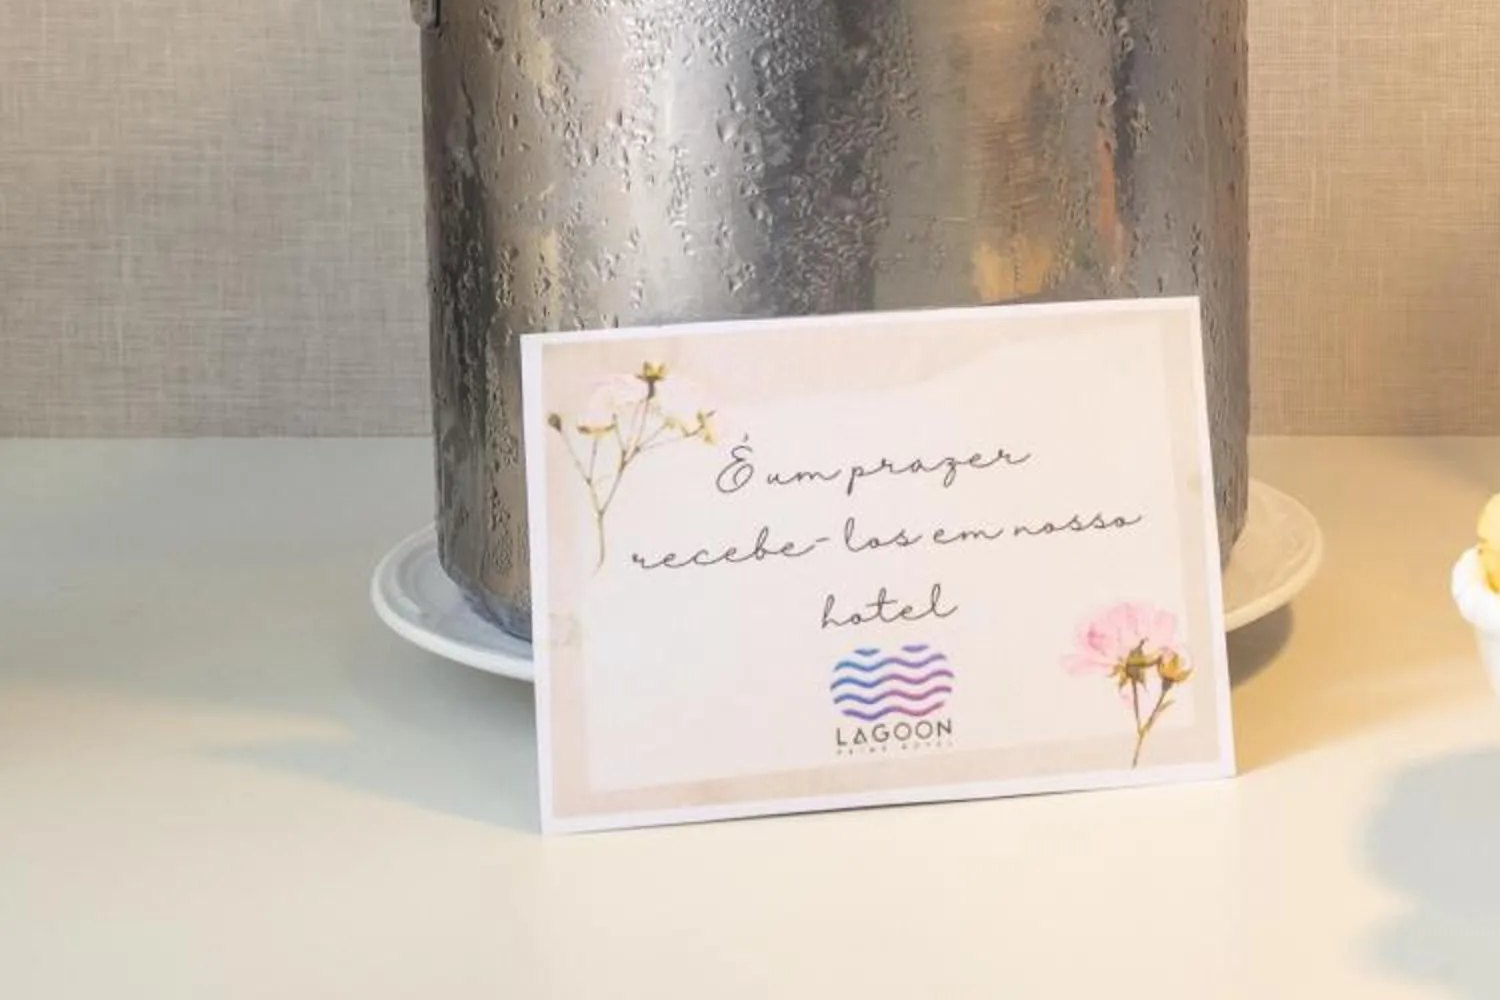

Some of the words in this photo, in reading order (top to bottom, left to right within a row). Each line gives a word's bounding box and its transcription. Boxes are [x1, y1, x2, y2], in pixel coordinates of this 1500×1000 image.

[716, 433, 754, 493] É
[766, 469, 841, 485] um
[845, 448, 1031, 496] prazer
[933, 527, 1004, 544] em
[1013, 512, 1143, 536] nosso
[821, 583, 958, 629] hotel
[835, 718, 952, 746] LAGOON
